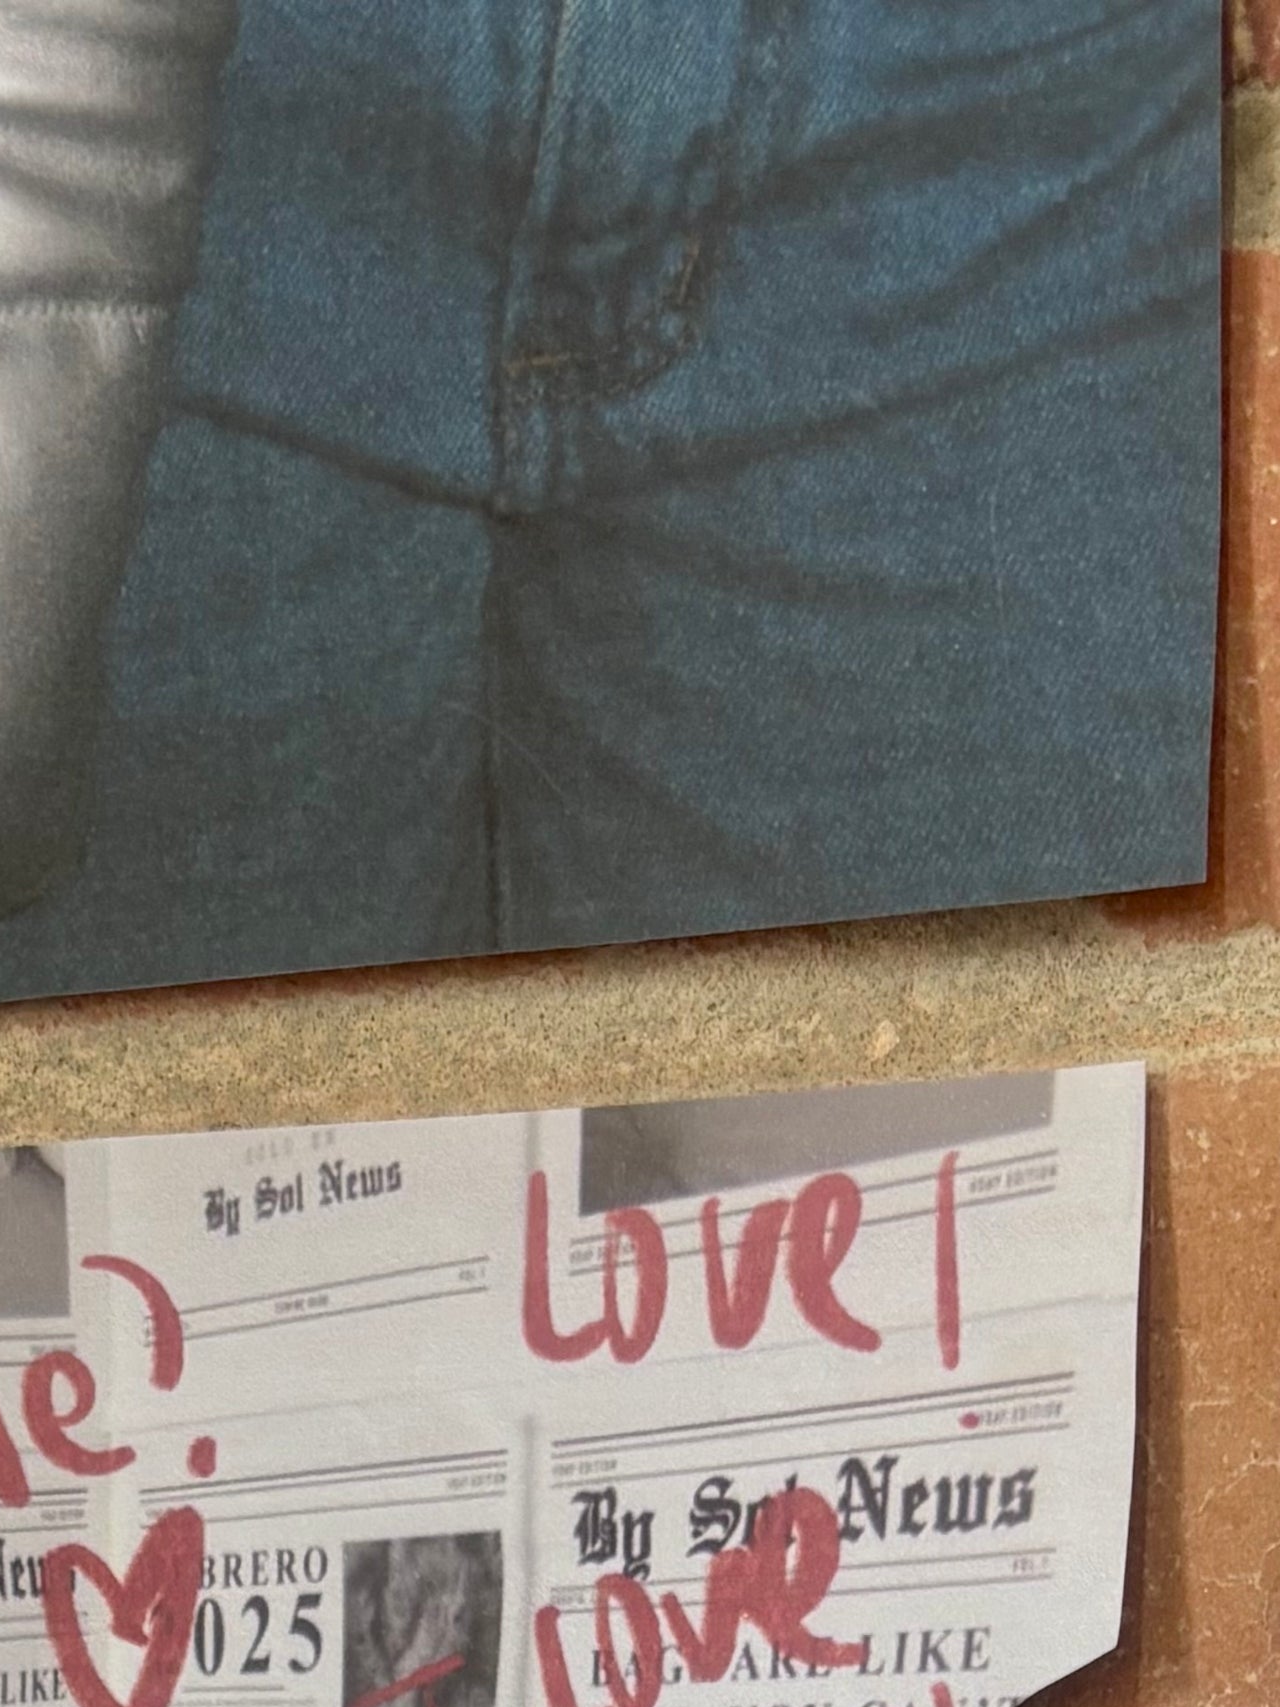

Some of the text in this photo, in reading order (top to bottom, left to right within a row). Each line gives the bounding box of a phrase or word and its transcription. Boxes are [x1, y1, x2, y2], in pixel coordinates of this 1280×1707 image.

[204, 1158, 404, 1237] By Sol News
[571, 1484, 656, 1581] By
[837, 1455, 1039, 1543] News
[858, 1624, 993, 1678] LIKE
[1, 1666, 68, 1706] LIKE
